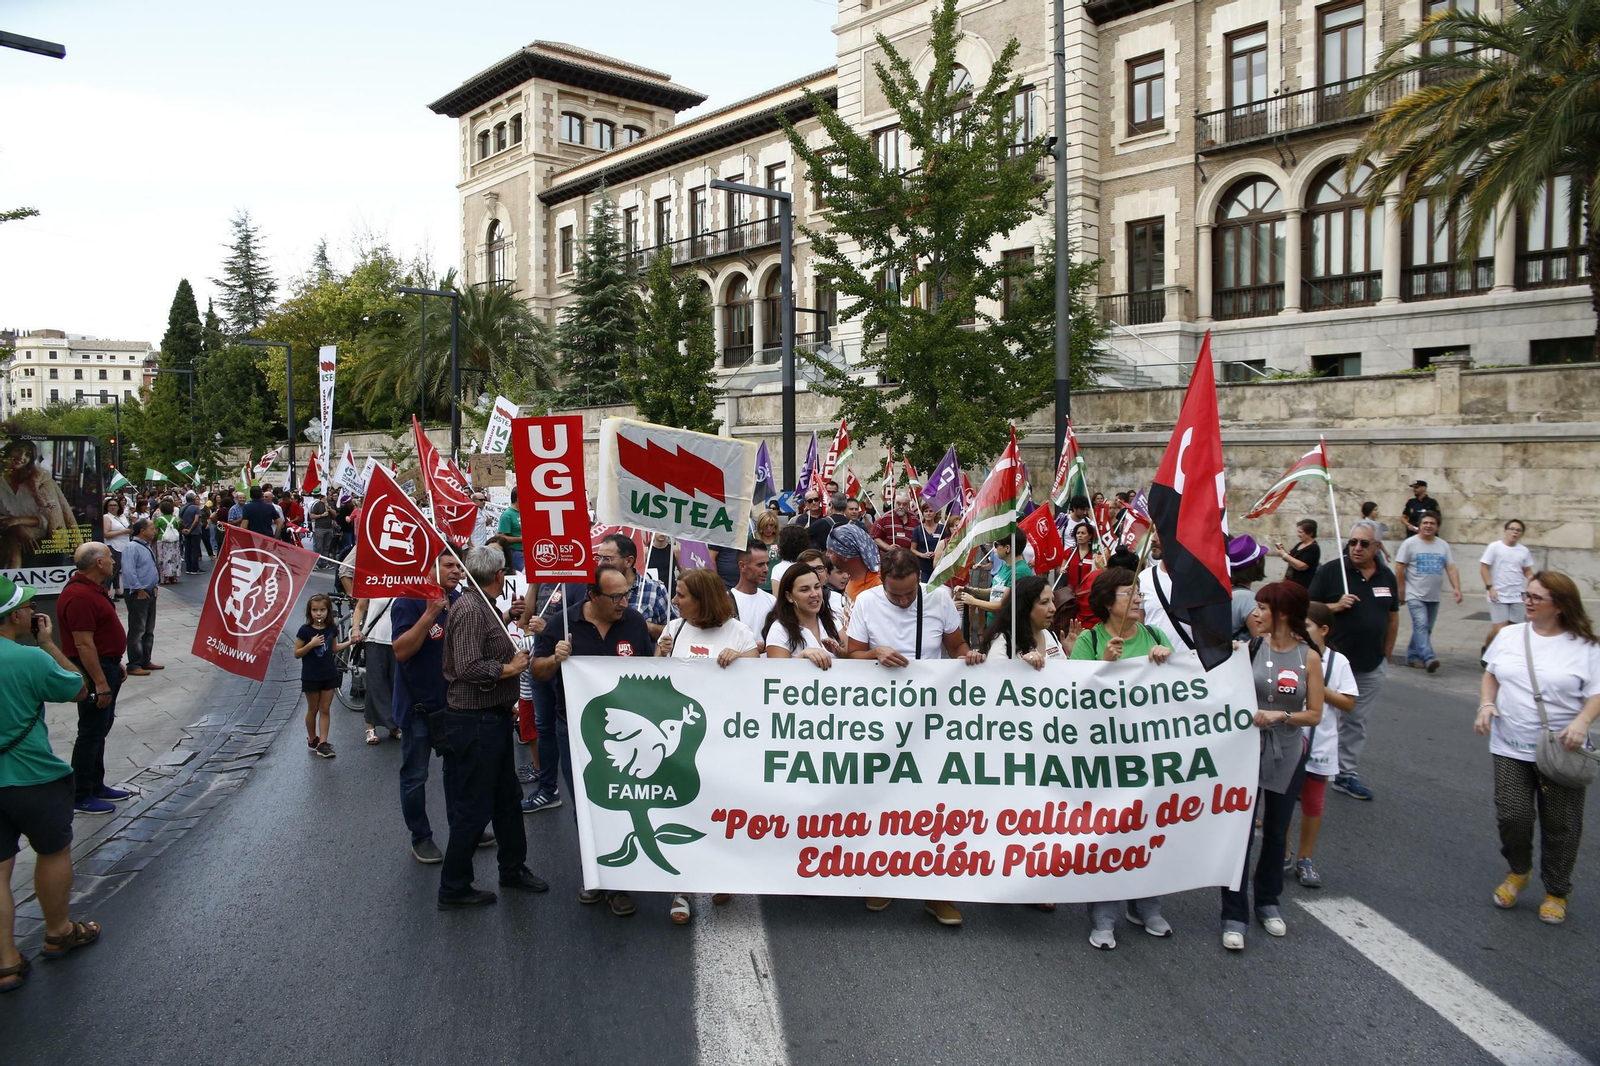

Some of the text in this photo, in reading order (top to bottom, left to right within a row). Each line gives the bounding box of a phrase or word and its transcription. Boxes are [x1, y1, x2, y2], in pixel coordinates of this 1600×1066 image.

[494, 414, 511, 427] USTE
[528, 424, 575, 536] UGT
[630, 489, 733, 532] USTEA
[3, 568, 78, 584] ANG
[764, 678, 1209, 710] Federación de Asociaciones
[723, 704, 1254, 748] de Madres y Padres de alumnado
[764, 747, 1218, 788] FAMPA ALHAMBRA
[608, 783, 678, 801] FAMPA
[797, 811, 872, 839] una
[880, 802, 988, 842] mejor
[996, 799, 1148, 836] calidad
[1156, 793, 1205, 828] de
[1211, 784, 1252, 815] la
[797, 842, 995, 878] Educación
